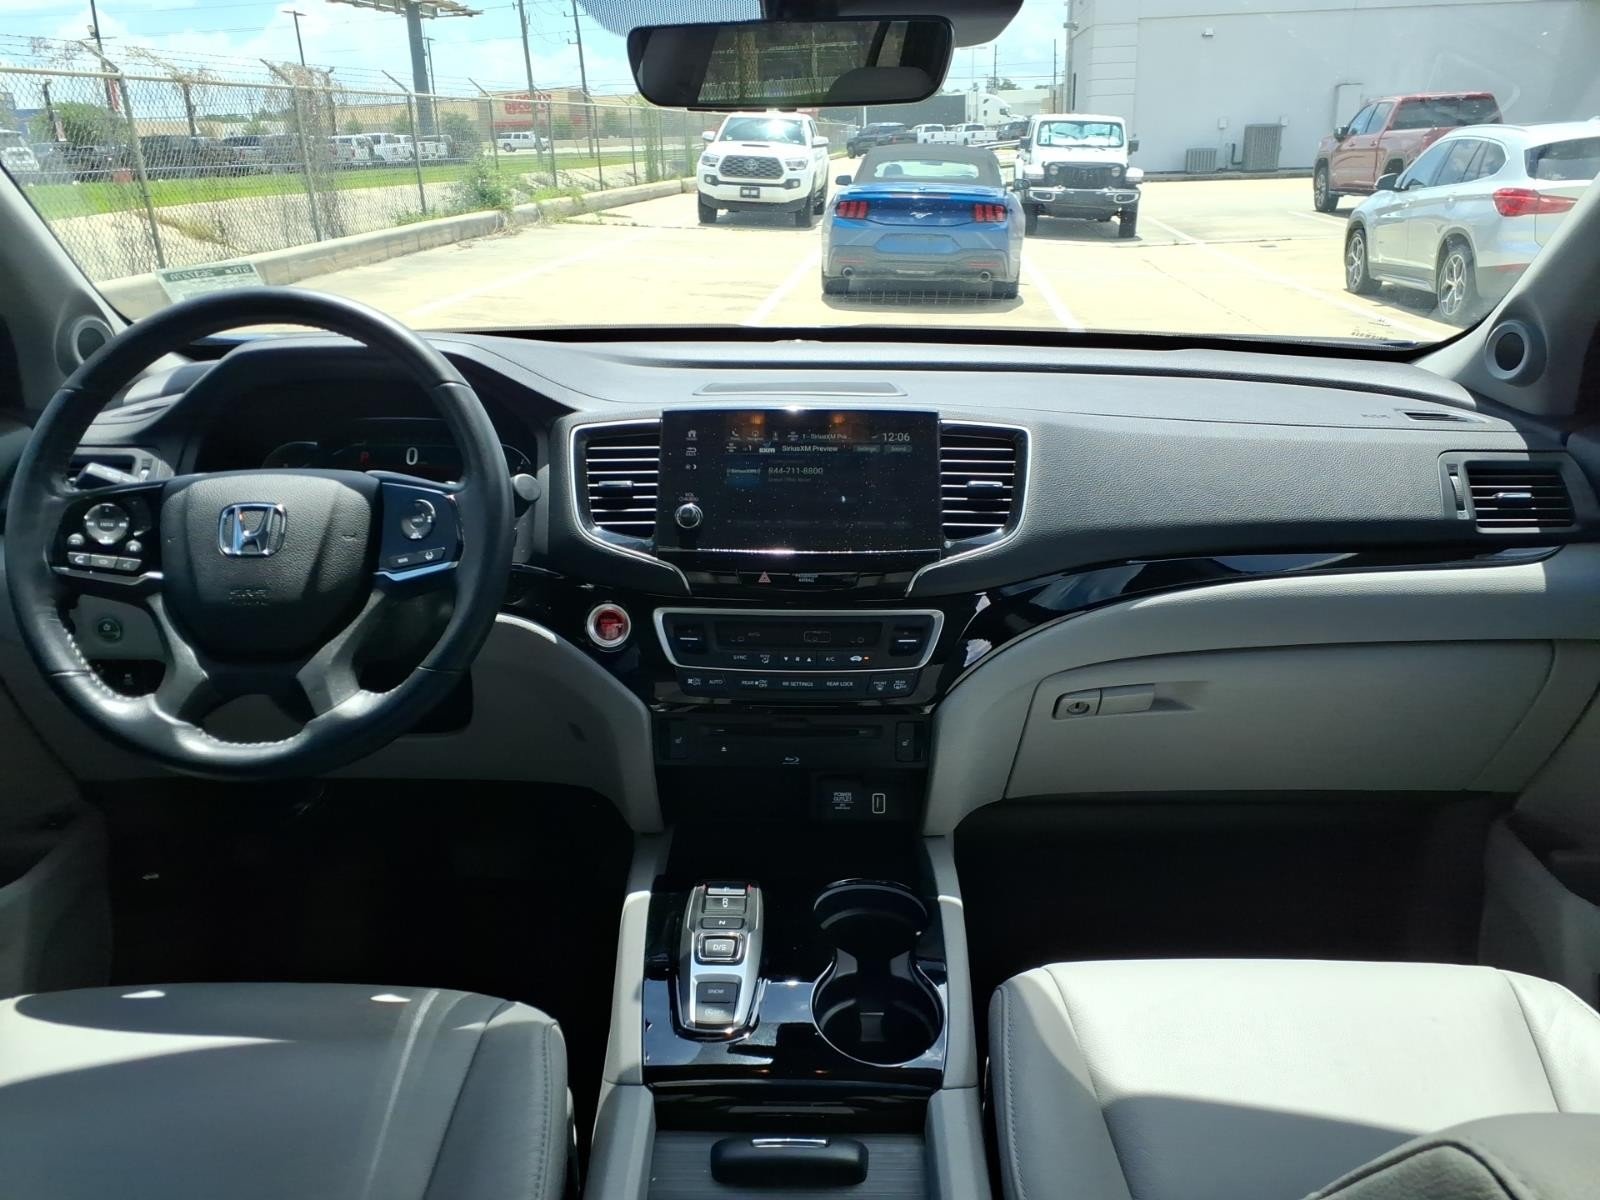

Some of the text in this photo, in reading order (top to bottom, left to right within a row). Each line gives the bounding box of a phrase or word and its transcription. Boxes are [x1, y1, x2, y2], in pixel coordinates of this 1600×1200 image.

[882, 432, 911, 442] 12:06
[781, 444, 811, 452] SiriusXM
[405, 446, 418, 466] 0
